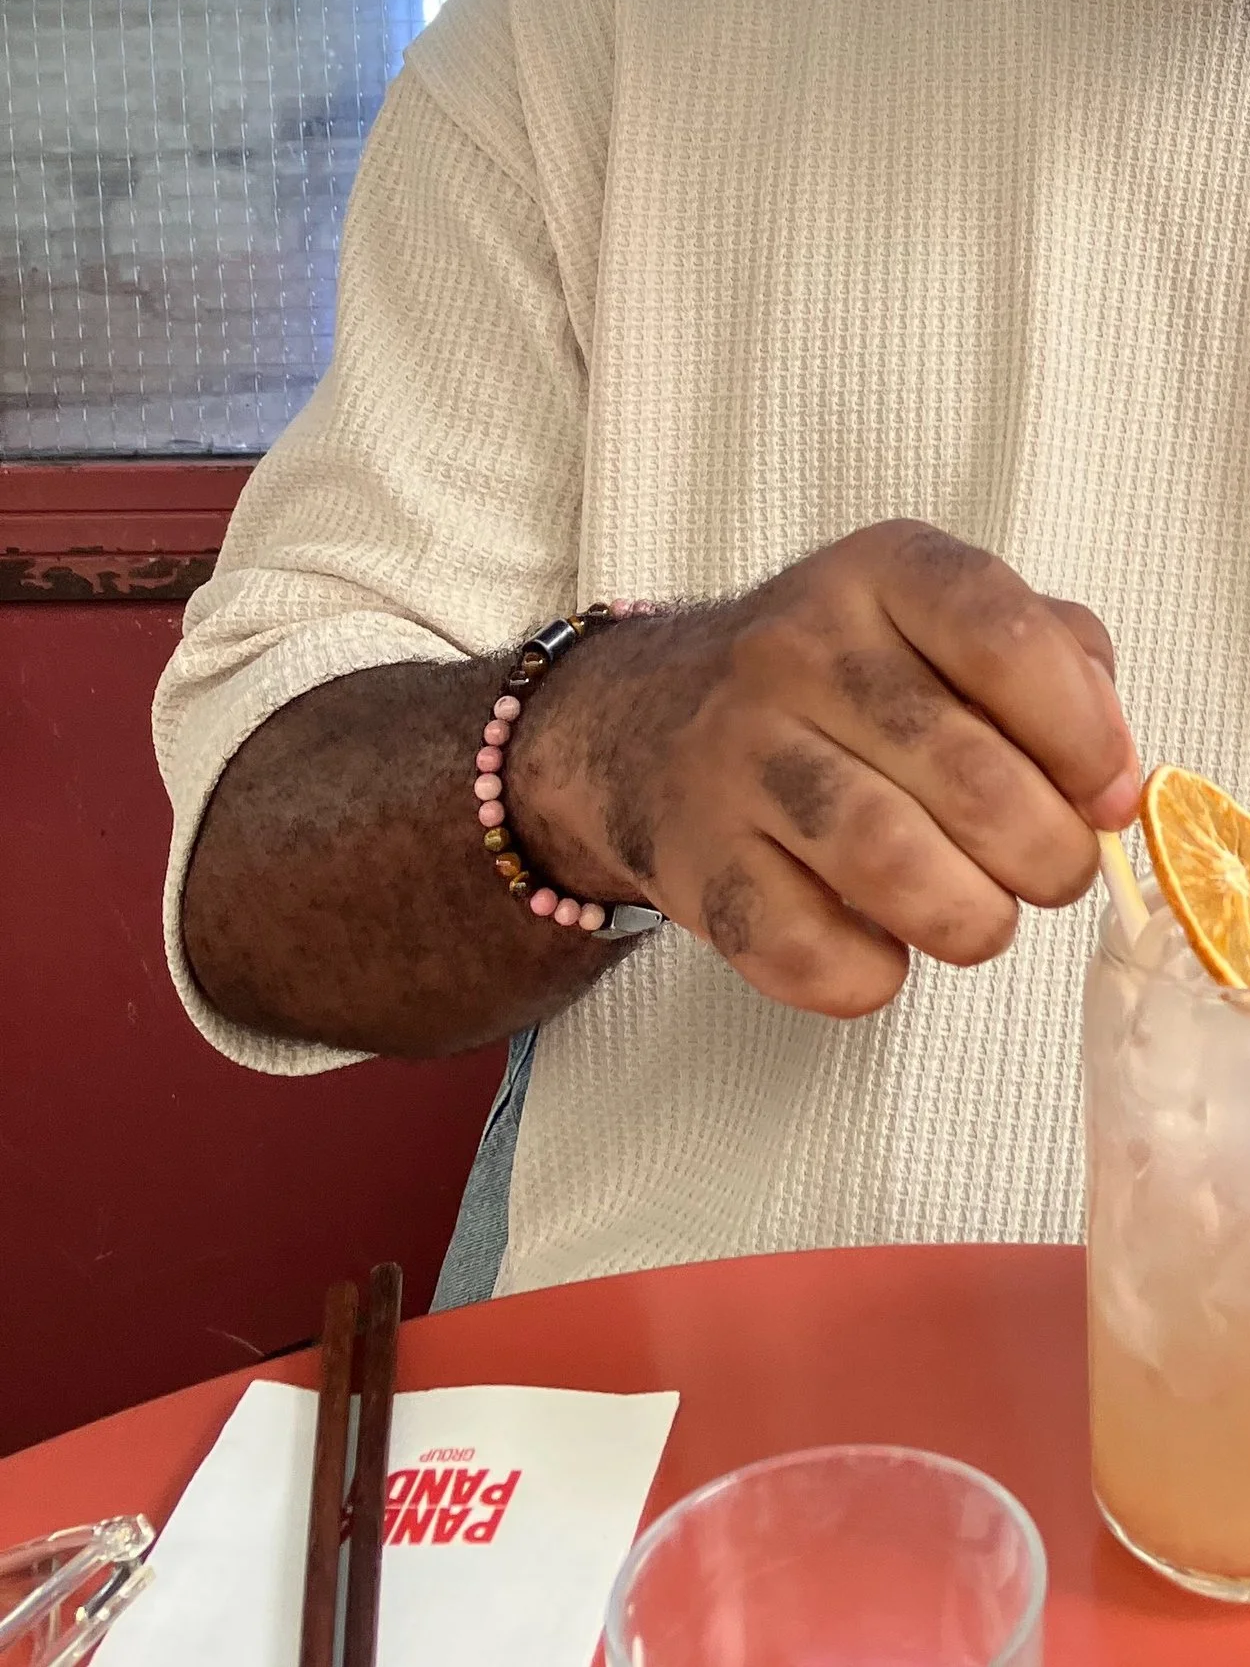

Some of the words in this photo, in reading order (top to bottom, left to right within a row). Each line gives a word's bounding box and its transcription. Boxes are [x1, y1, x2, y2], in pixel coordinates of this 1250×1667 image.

[419, 1447, 475, 1462] GROUP
[348, 1470, 522, 1508] PAND
[340, 1507, 506, 1545] PAN
